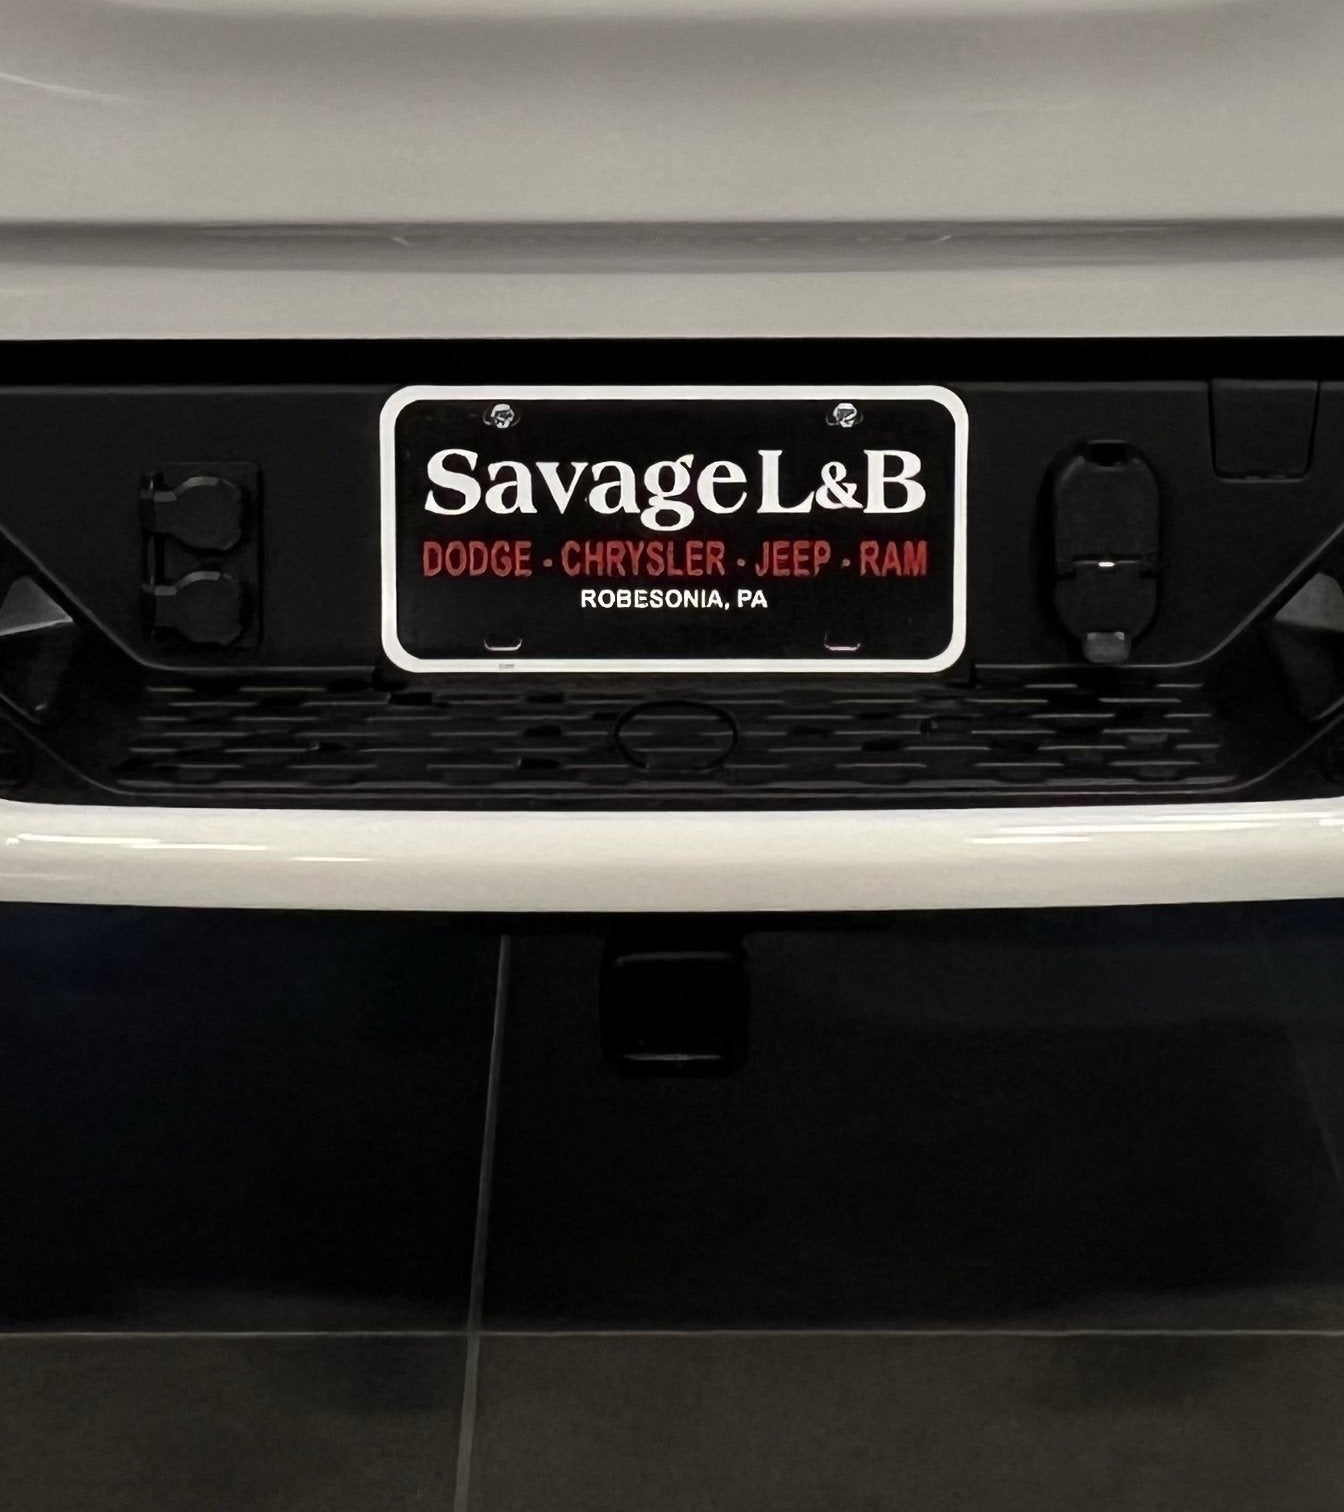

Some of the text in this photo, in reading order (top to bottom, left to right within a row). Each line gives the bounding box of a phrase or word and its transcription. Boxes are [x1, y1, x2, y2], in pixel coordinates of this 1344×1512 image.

[422, 539, 927, 577] DODGE CHRYSLER JEEP RAM
[580, 588, 768, 611] ROBESONIA, PA
